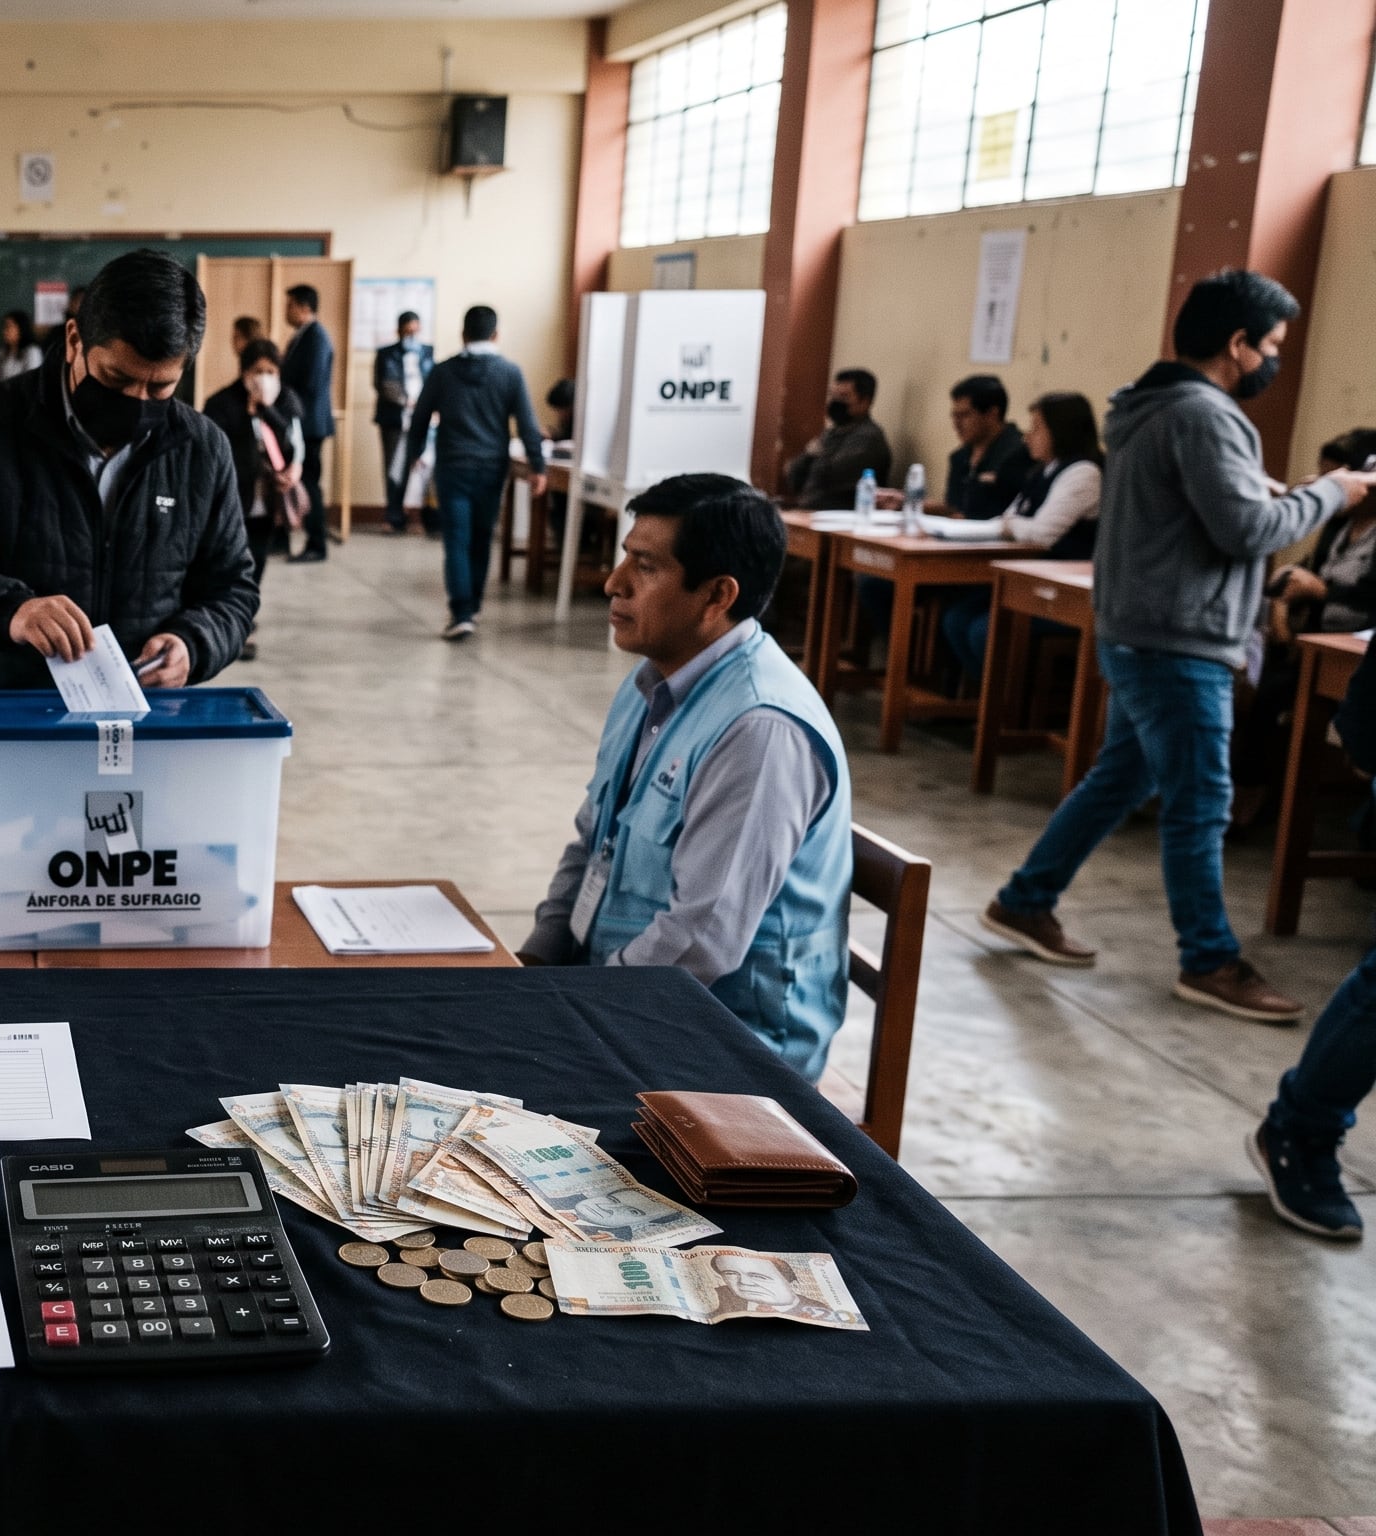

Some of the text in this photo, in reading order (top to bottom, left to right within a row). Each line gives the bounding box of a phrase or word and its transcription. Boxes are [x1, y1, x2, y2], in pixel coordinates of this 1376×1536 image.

[660, 380, 731, 400] ONPE
[48, 850, 177, 888] ONPE
[27, 892, 201, 908] ÁNFORA DE SUFRAGIO
[29, 1164, 74, 1172] CASIO
[92, 1261, 105, 1270] 7
[132, 1259, 145, 1268] 8
[172, 1257, 185, 1266] 9
[618, 1260, 654, 1290] 100
[97, 1281, 109, 1291] 4
[138, 1280, 151, 1289] 5
[177, 1278, 191, 1287] 6
[52, 1305, 66, 1314] C
[103, 1302, 112, 1312] 1
[142, 1301, 156, 1310] 2
[184, 1299, 197, 1308] 3
[55, 1327, 70, 1336] E
[103, 1324, 117, 1334] 0
[142, 1321, 167, 1332] 00
